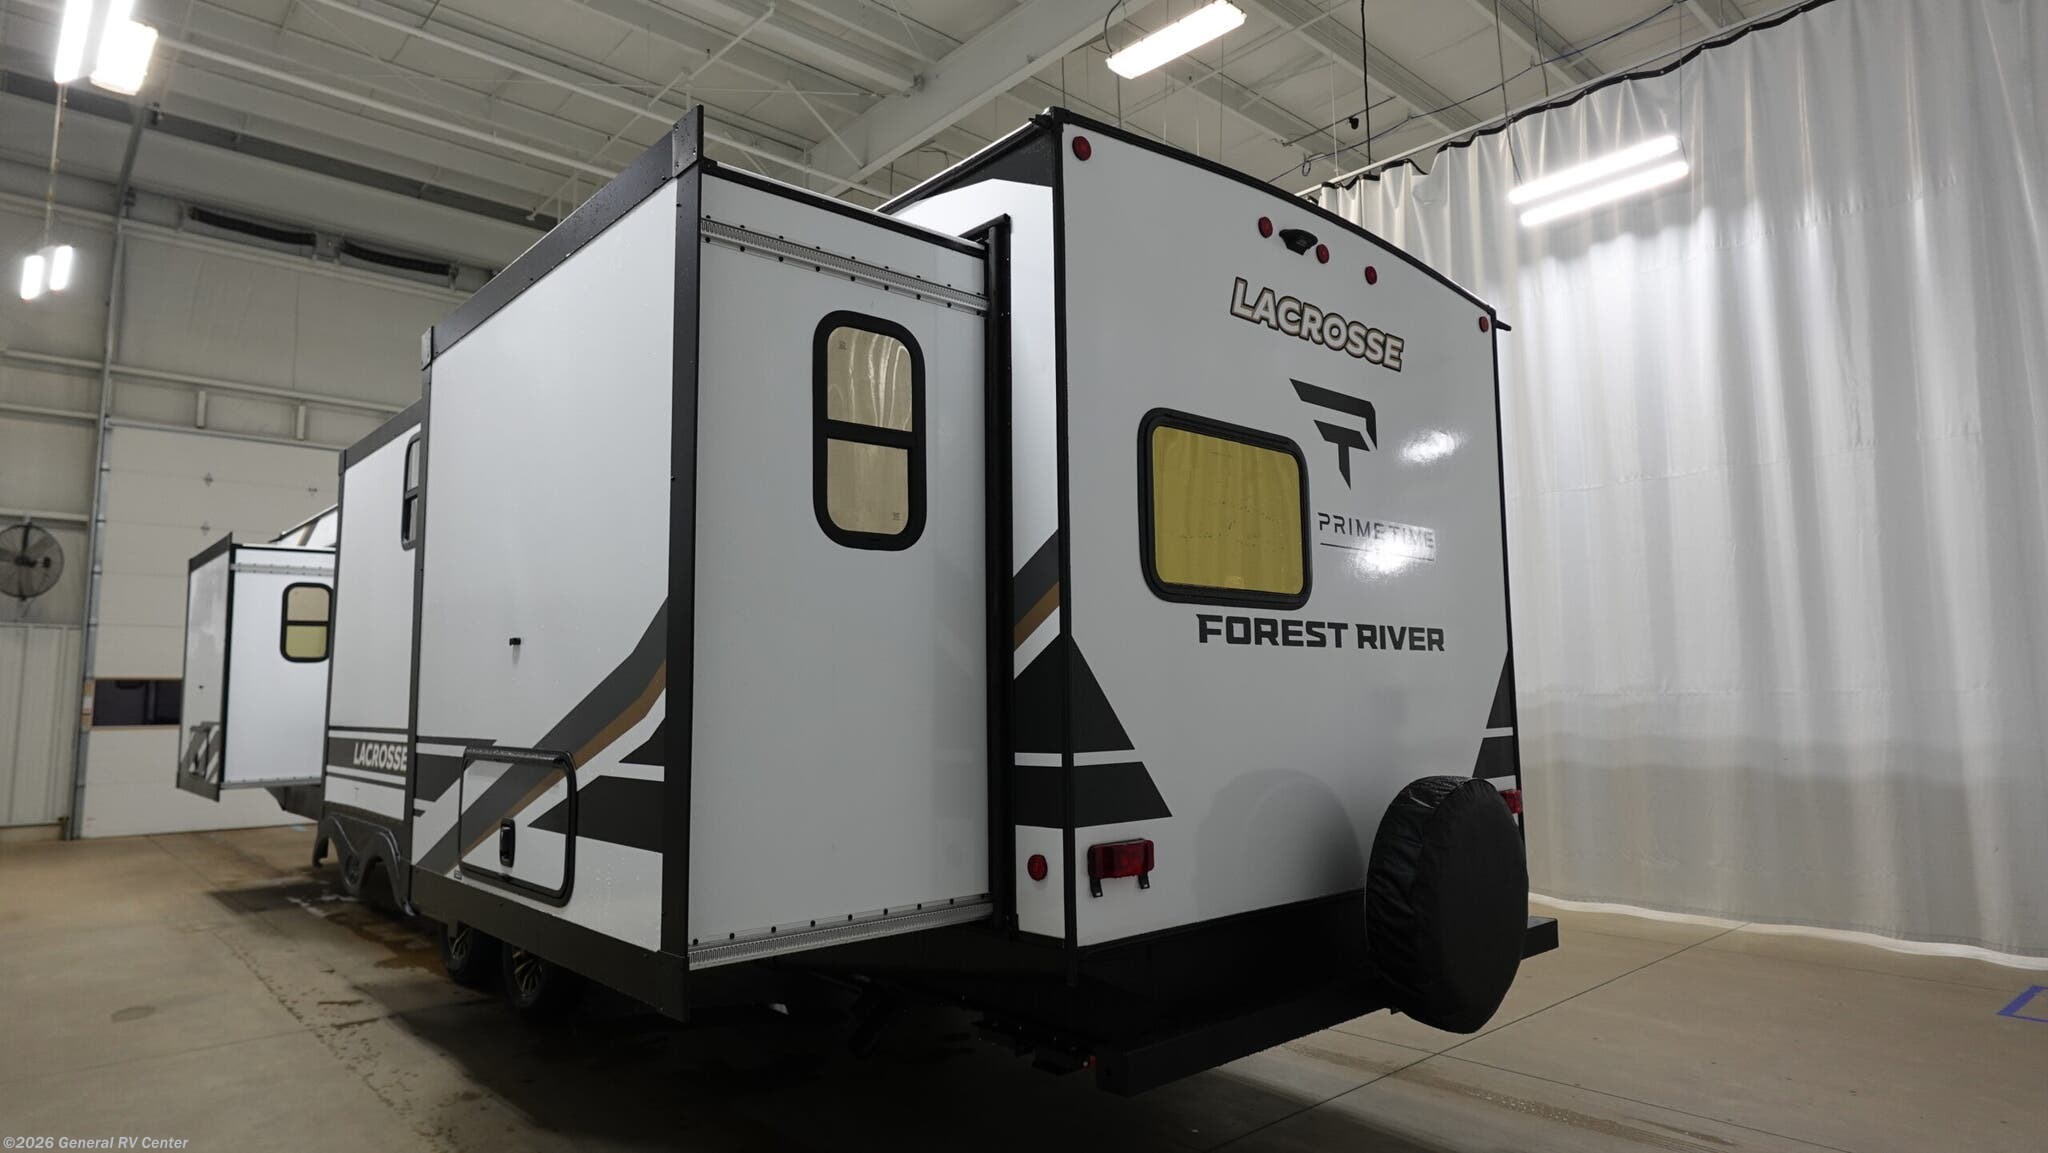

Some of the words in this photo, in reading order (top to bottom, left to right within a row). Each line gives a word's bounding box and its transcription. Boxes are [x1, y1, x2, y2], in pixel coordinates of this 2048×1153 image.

[1231, 277, 1404, 372] LACROSSE
[1196, 614, 1348, 648] FOREST
[1355, 624, 1445, 651] RIVER
[353, 742, 407, 771] LACROSSE
